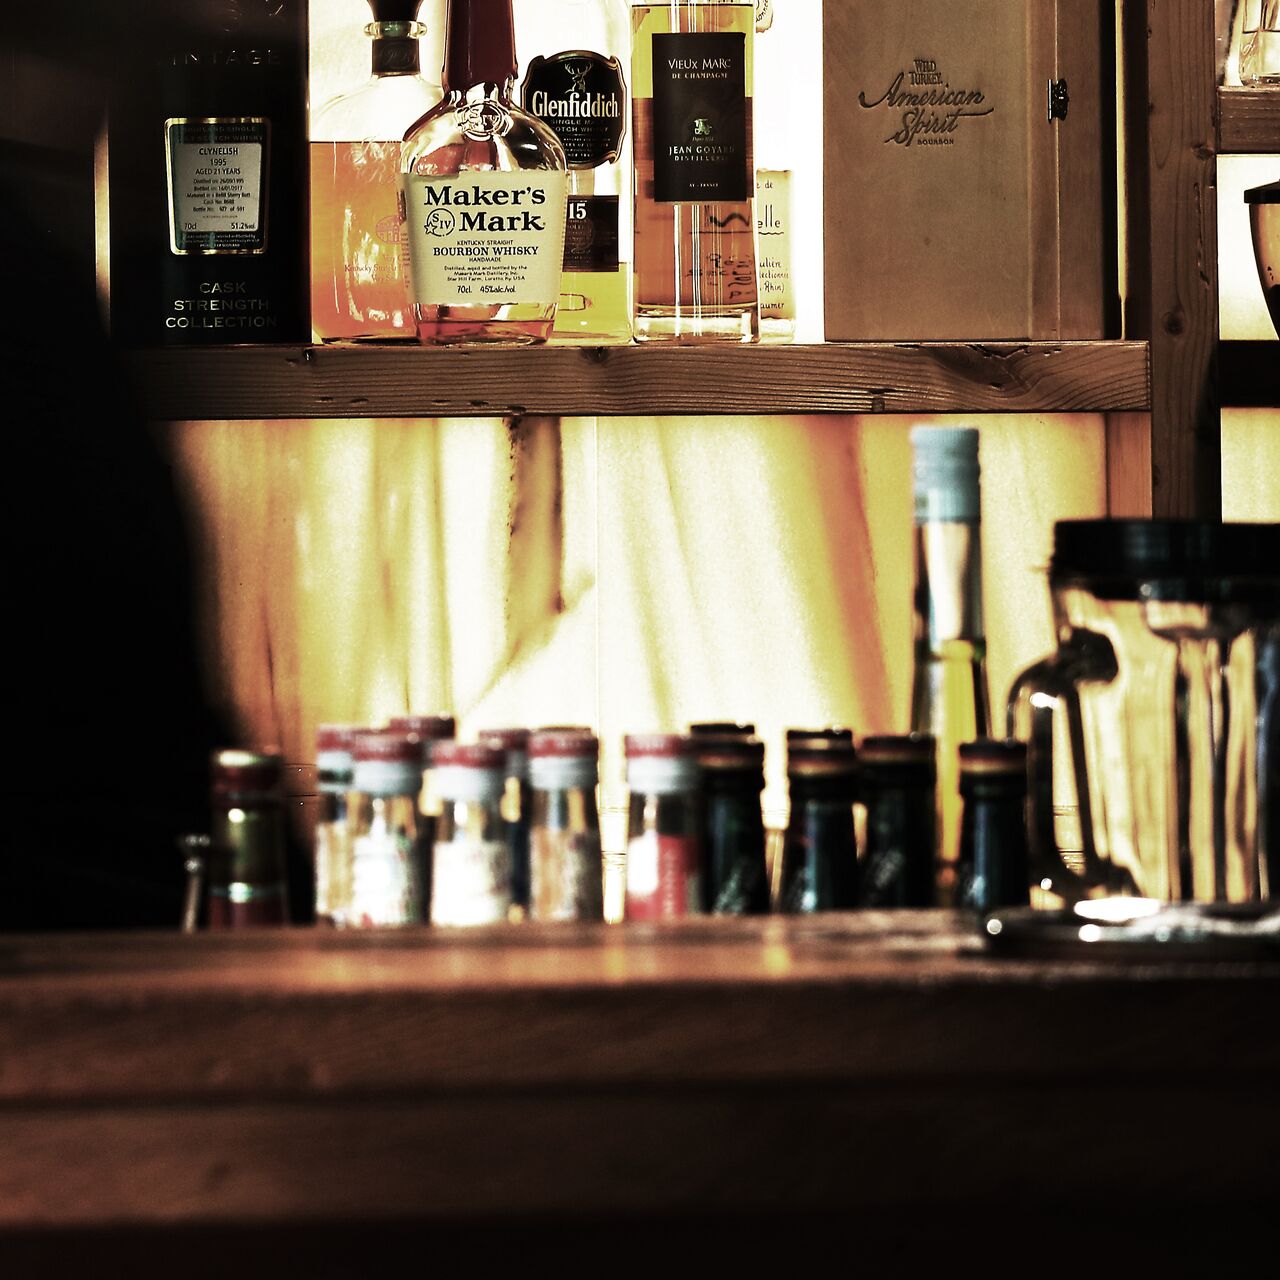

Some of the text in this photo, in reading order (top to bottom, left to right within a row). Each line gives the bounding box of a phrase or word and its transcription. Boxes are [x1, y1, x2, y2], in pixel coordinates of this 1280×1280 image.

[668, 59, 731, 70] VIEUX MARC
[914, 59, 936, 71] WILD
[909, 72, 940, 85] TURKEY
[859, 74, 985, 107] American
[532, 91, 618, 117] Glenfiddich
[885, 107, 994, 146] Spirit
[424, 186, 546, 206] Maker's
[568, 202, 587, 219] 15
[459, 211, 544, 232] Mark
[434, 246, 538, 257] BOURBON WHISKY
[199, 282, 246, 294] CASK
[174, 300, 269, 311] STRENGTH
[165, 316, 276, 328] COLLECTION
